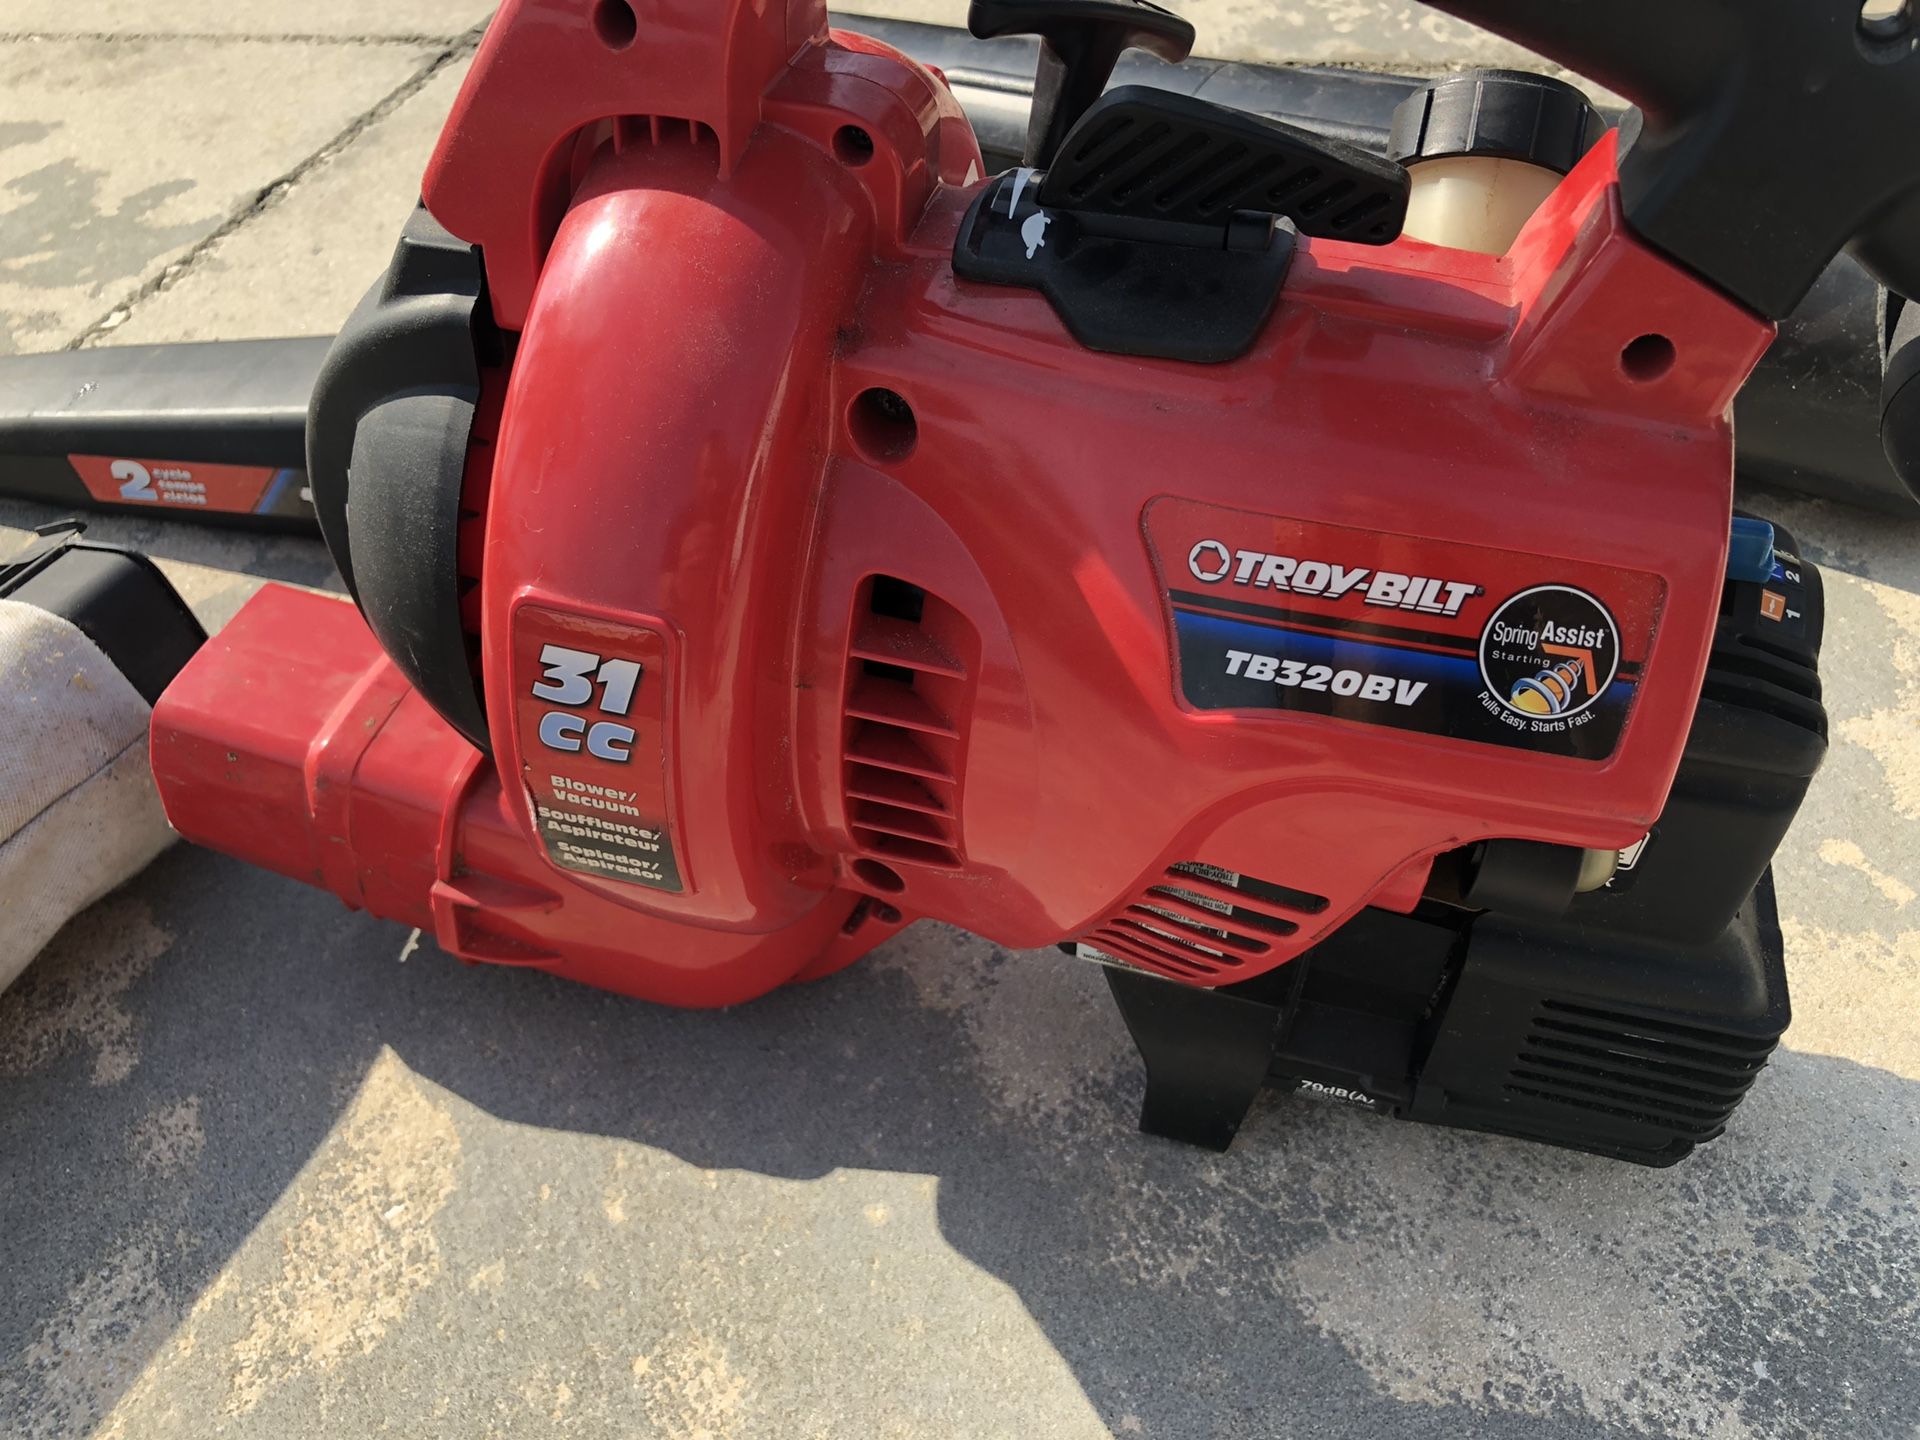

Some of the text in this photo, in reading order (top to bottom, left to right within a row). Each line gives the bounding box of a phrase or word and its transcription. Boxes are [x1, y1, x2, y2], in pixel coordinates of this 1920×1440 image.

[111, 459, 158, 500] 2
[1785, 570, 1800, 583] 2
[1785, 608, 1800, 619] 1
[1493, 621, 1605, 650] Spring Assist
[1492, 650, 1550, 668] Starting
[531, 643, 642, 716] 31
[1225, 649, 1428, 706] TB320BV
[1477, 690, 1596, 733] Pulls Easy. Starts Fast.
[550, 775, 637, 802] Blower/
[553, 789, 640, 817] Vacuum
[538, 806, 661, 841] Soufflante/
[547, 820, 660, 852] Aspirateur
[557, 841, 660, 870] Soplador/
[563, 852, 663, 880] Aspirador
